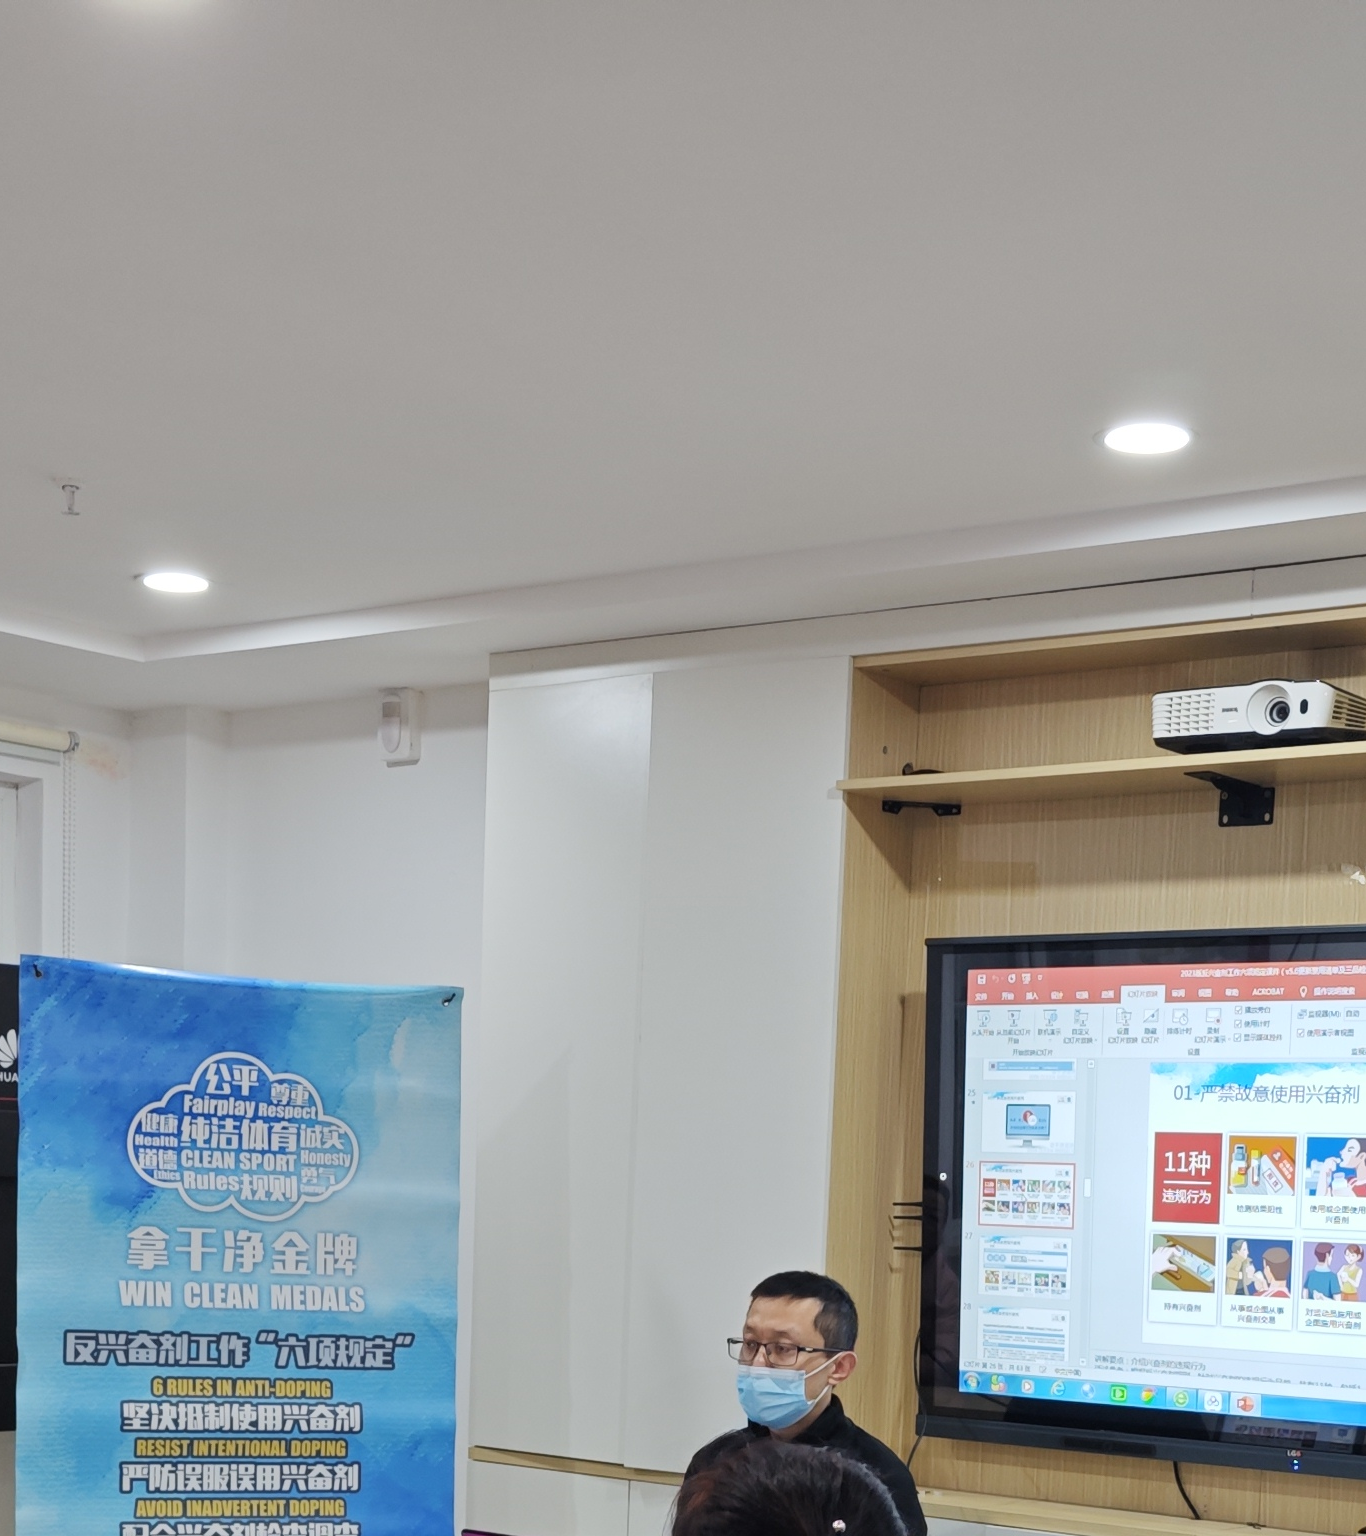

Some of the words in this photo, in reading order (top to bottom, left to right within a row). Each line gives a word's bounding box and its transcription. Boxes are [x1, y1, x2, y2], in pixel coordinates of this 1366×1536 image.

[205, 1063, 259, 1096] 公平
[271, 1083, 310, 1106] 尊重
[968, 1089, 976, 1097] 25
[184, 1094, 255, 1118] Fairplay
[258, 1103, 318, 1120] Respect
[141, 1113, 178, 1134] 健康
[180, 1116, 299, 1152] 纯洁体育
[135, 1134, 178, 1147] Health
[300, 1124, 346, 1150] 诚实
[138, 1149, 178, 1170] 道德
[181, 1151, 235, 1169] CLEAN
[239, 1152, 297, 1172] SPORT
[301, 1150, 351, 1168] Honesty
[1164, 1150, 1212, 1176] 11种
[154, 1170, 180, 1181] Ethics
[301, 1168, 335, 1185] 勇气
[185, 1171, 239, 1191] Rules
[240, 1174, 297, 1202] 规则
[1162, 1188, 1212, 1205] 违规行为
[126, 1225, 358, 1277] 拿干净金牌
[119, 1280, 172, 1307] WIN
[184, 1282, 259, 1309] CLEAN
[271, 1285, 366, 1312] MEDALS
[152, 1378, 163, 1396] 6
[167, 1378, 212, 1396] RULES
[217, 1379, 232, 1396] IN
[235, 1379, 332, 1398] ANTI-DOPING
[122, 1403, 361, 1432] 坚决抵制使用兴奋剂
[136, 1440, 189, 1457] RESIST
[193, 1440, 287, 1457] INTENTIONAL
[290, 1441, 346, 1457] DOPING
[122, 1464, 359, 1491] 严防误服误用兴奋剂
[136, 1500, 183, 1517] AVOID
[186, 1500, 286, 1517] INADVERTENT
[289, 1500, 344, 1517] DOPING
